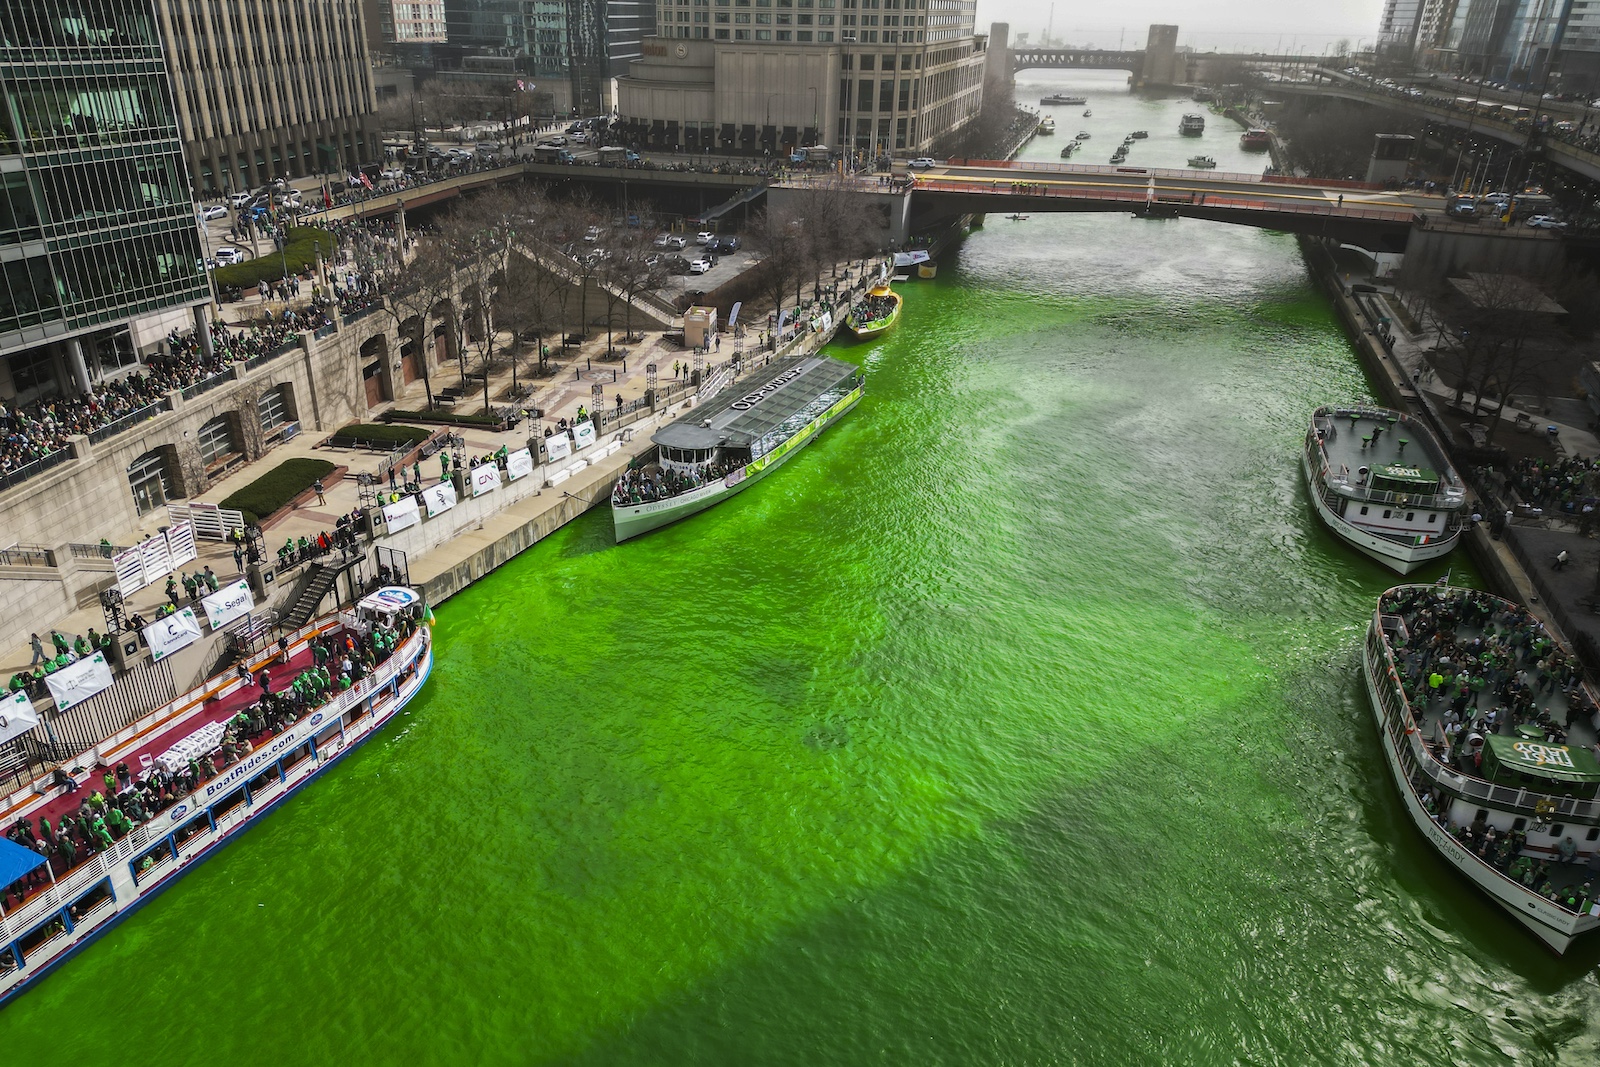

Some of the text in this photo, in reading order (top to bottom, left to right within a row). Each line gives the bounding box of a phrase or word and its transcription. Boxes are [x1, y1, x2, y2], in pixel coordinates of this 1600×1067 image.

[731, 367, 802, 411] ODYSSEY
[478, 472, 494, 486] CN
[224, 593, 248, 611] Segal
[206, 733, 295, 797] BoatRides.com
[1520, 751, 1575, 768] FIRST
[1429, 828, 1465, 863] FIRST LADY
